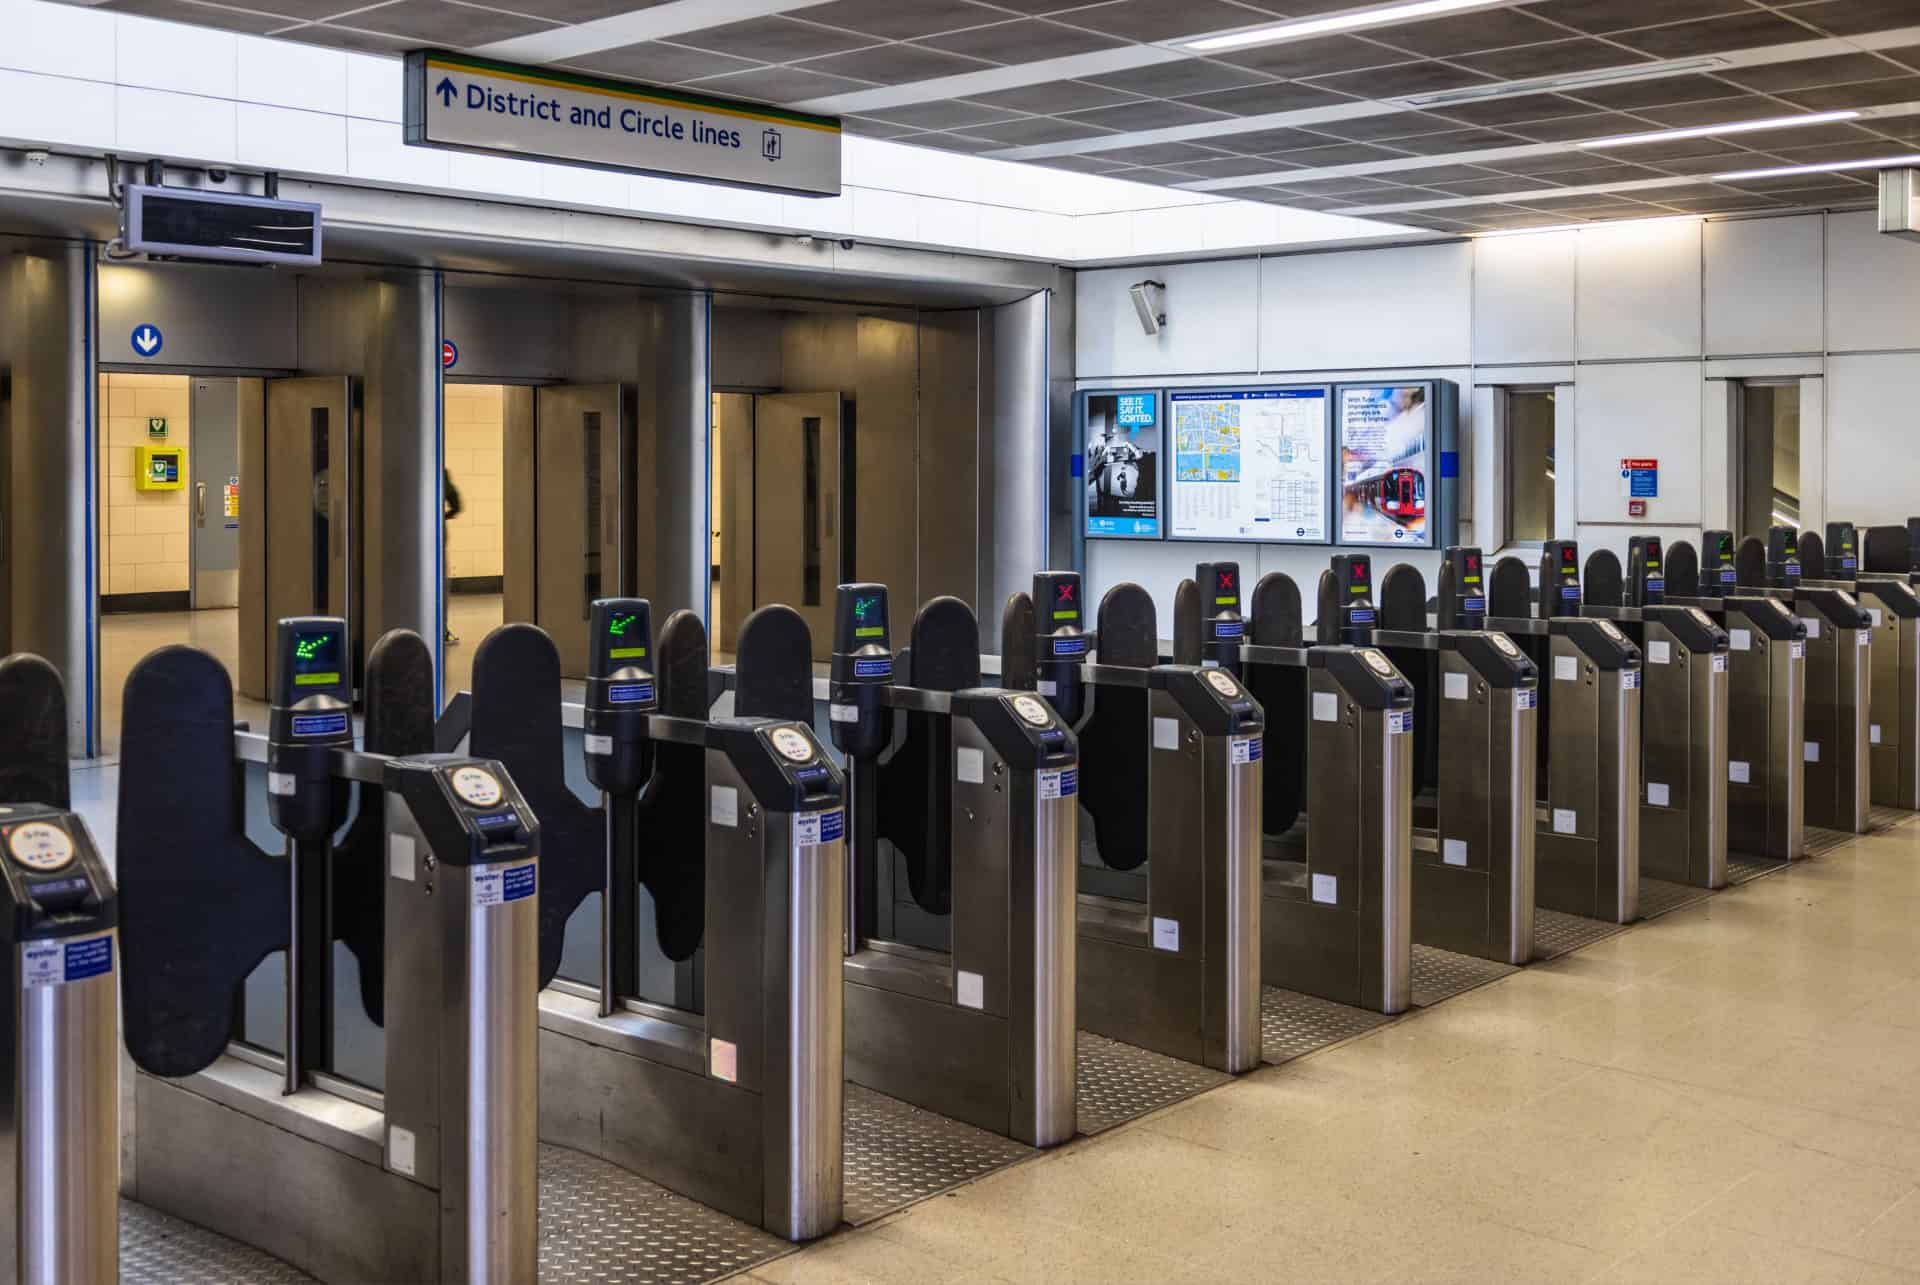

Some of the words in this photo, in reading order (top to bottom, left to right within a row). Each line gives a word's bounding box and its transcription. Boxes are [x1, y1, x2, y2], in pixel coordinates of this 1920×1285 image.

[466, 84, 561, 122] District
[570, 104, 611, 130] and
[620, 109, 684, 140] Circle
[692, 119, 741, 149] lines
[1119, 396, 1134, 406] SEE
[1119, 406, 1134, 415] SAY
